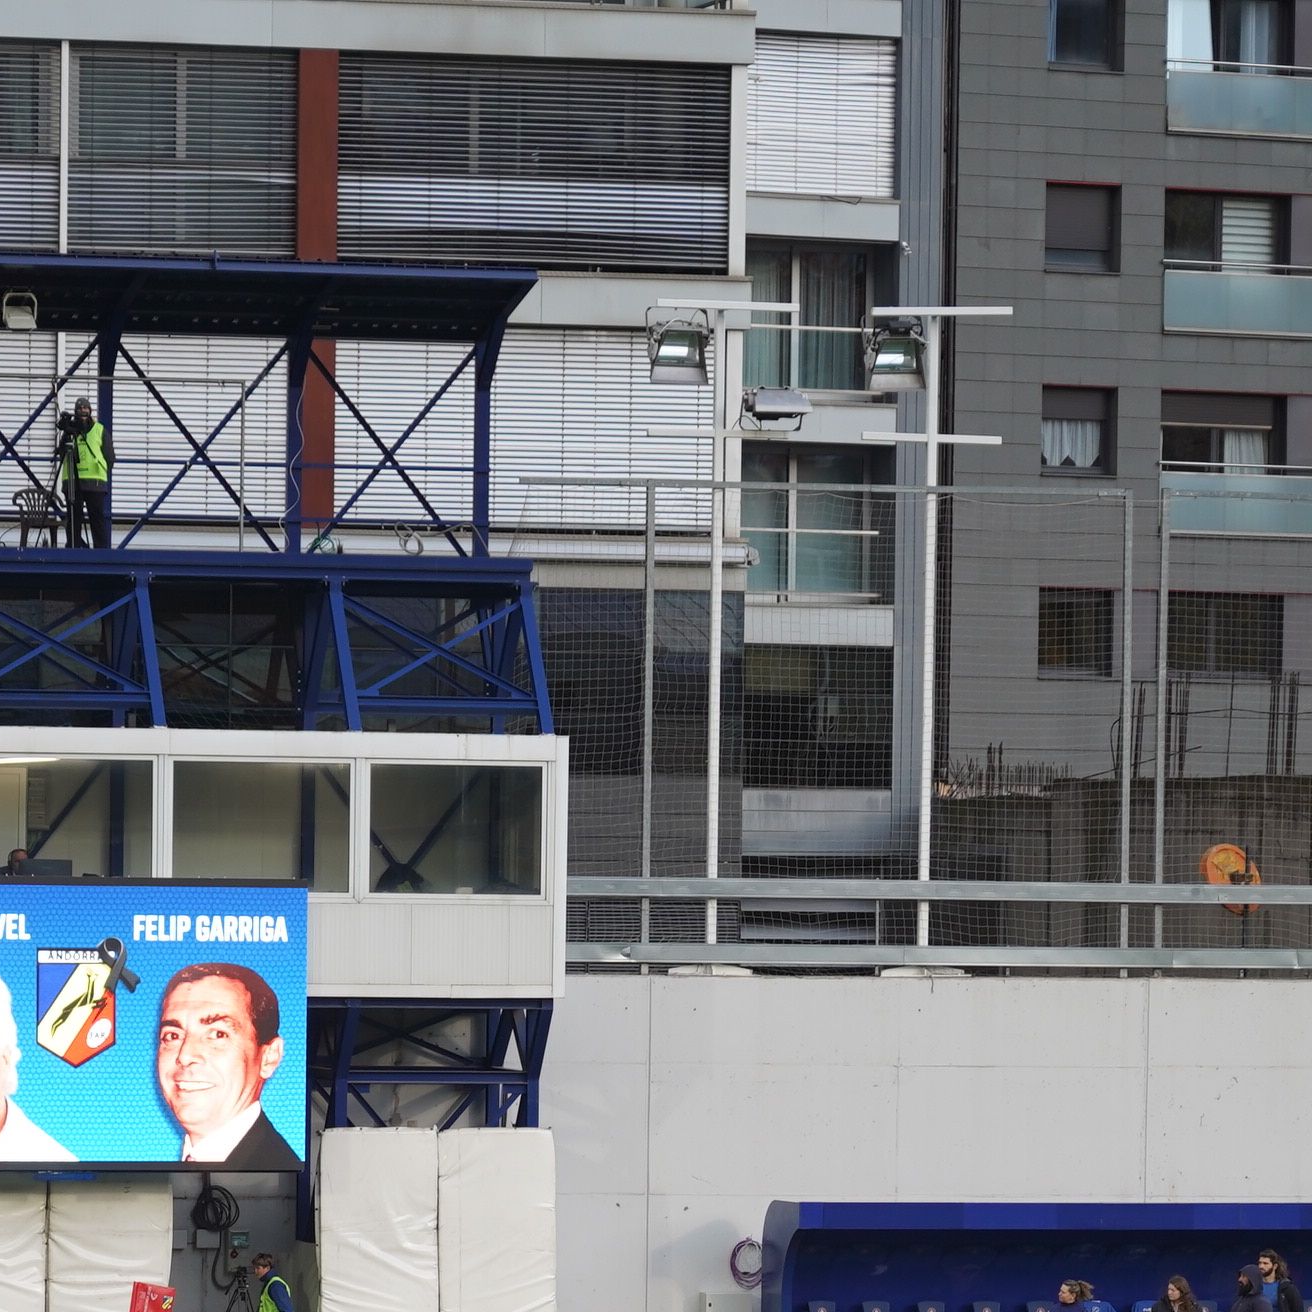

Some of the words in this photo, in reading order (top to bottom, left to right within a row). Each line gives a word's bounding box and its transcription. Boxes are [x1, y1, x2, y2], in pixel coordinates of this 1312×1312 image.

[132, 914, 192, 942] FELIP
[195, 915, 289, 943] GARRIGA
[48, 951, 99, 961] ANDORR
